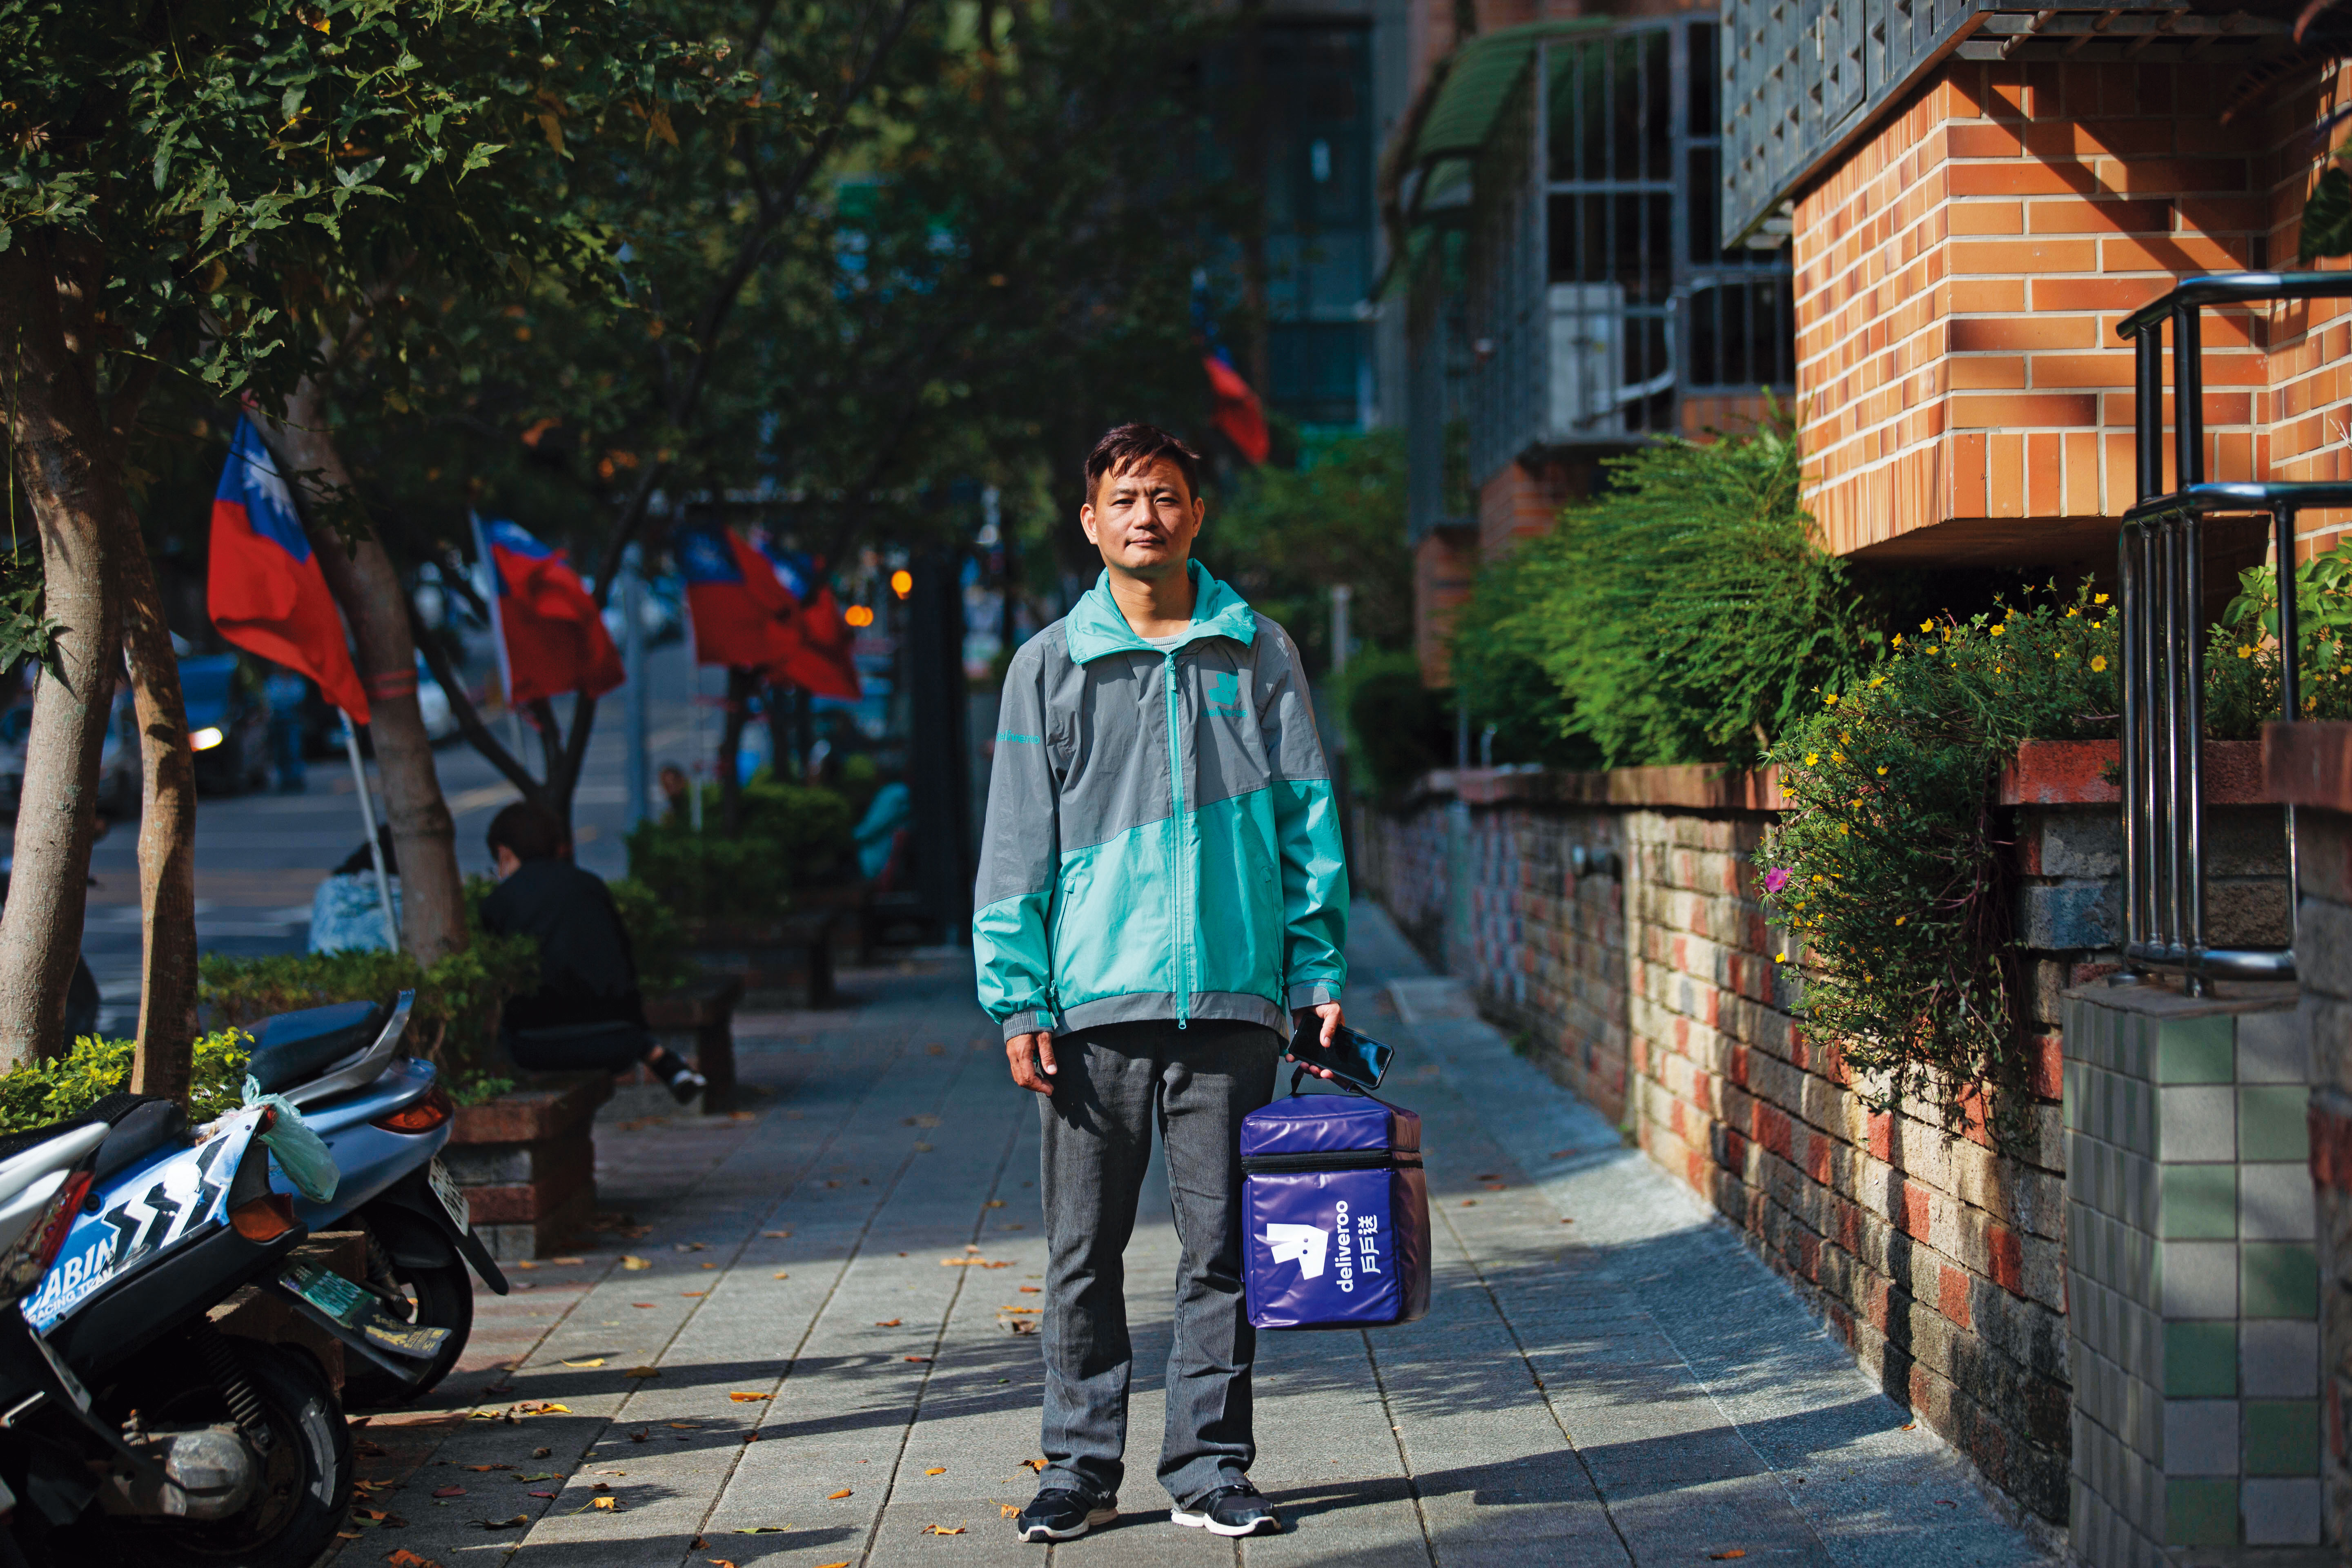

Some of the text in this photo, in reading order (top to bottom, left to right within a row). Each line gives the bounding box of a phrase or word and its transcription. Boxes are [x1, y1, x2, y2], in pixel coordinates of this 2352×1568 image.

[1202, 706, 1248, 717] deliveroo
[996, 729, 1040, 744] deliveroo
[1334, 1200, 1354, 1293] deliveroo
[1357, 1214, 1381, 1274] 戶戶送
[28, 1289, 76, 1324] RACING
